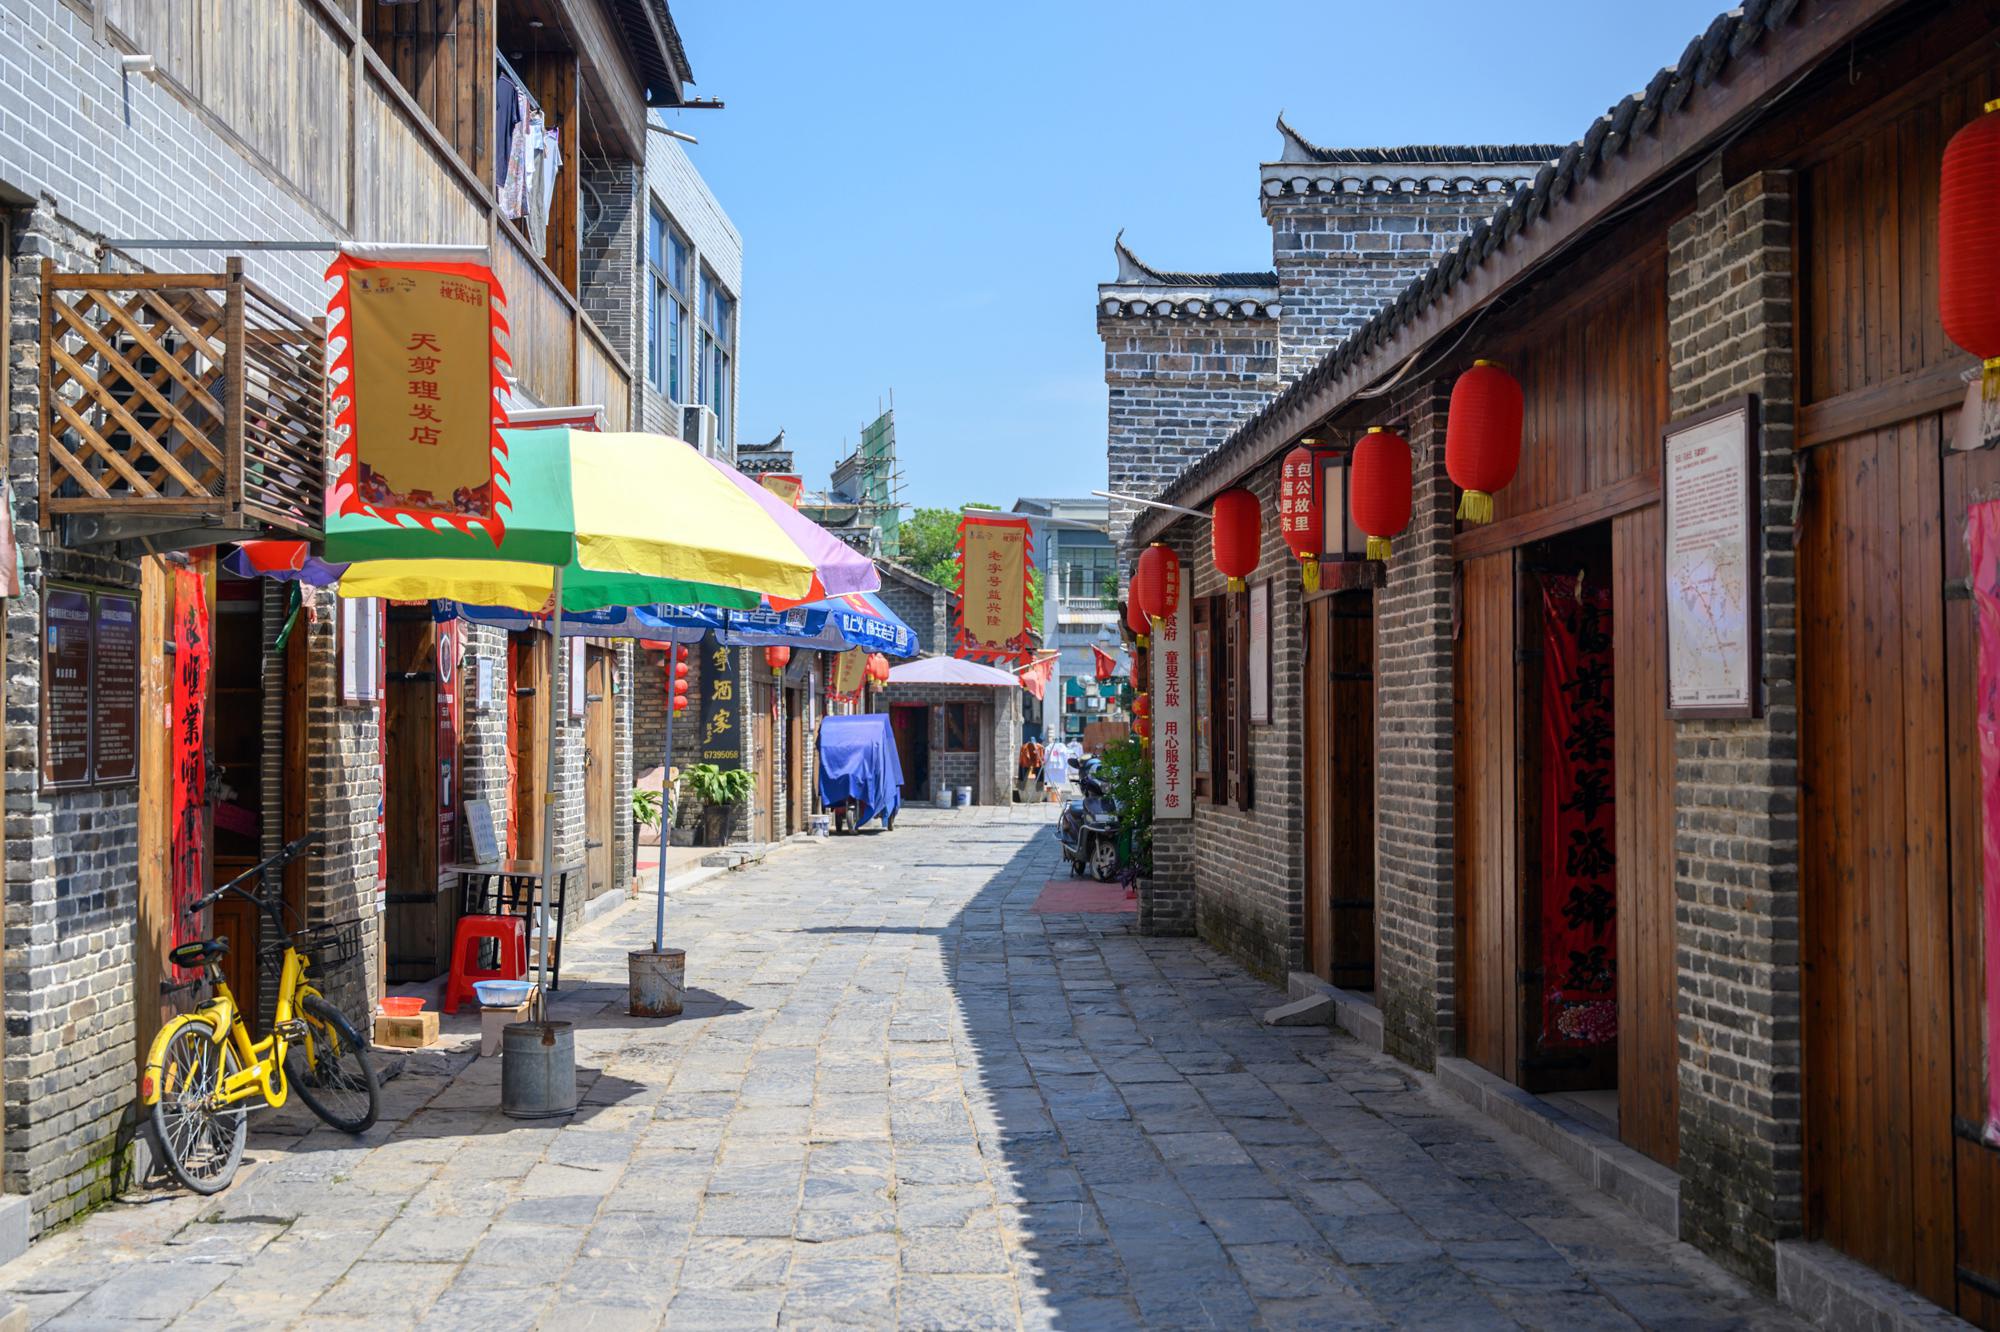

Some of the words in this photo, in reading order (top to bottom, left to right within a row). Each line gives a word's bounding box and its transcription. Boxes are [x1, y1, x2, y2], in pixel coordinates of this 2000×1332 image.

[407, 333, 442, 446] 天剪理发店
[1282, 464, 1294, 532] 幸福肥东
[1294, 463, 1311, 531] 包公故里
[986, 550, 1002, 626] 老字号益兴隆
[1164, 650, 1180, 707] 童叟无欺
[1164, 721, 1180, 808] 用心服务于您
